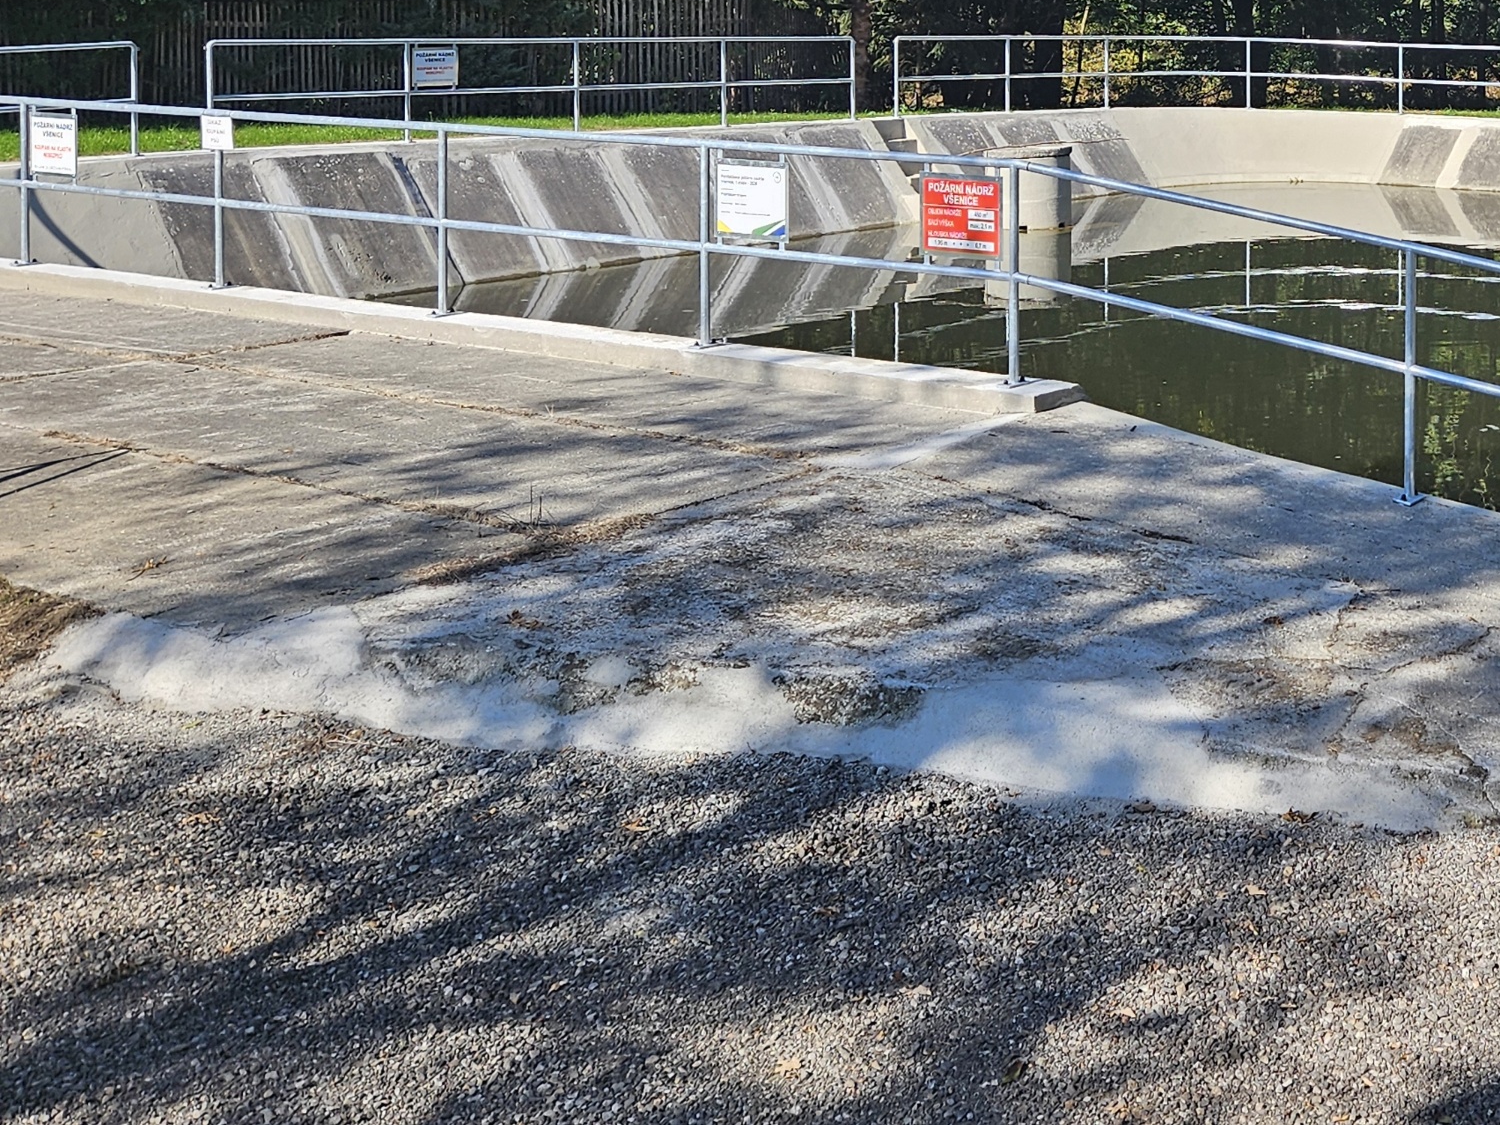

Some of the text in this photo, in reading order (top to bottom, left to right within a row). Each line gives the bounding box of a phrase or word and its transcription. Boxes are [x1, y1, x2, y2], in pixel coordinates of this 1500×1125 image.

[928, 180, 994, 196] POŽÁRNÍ NÁDRŽ
[943, 193, 979, 206] VŠENICE
